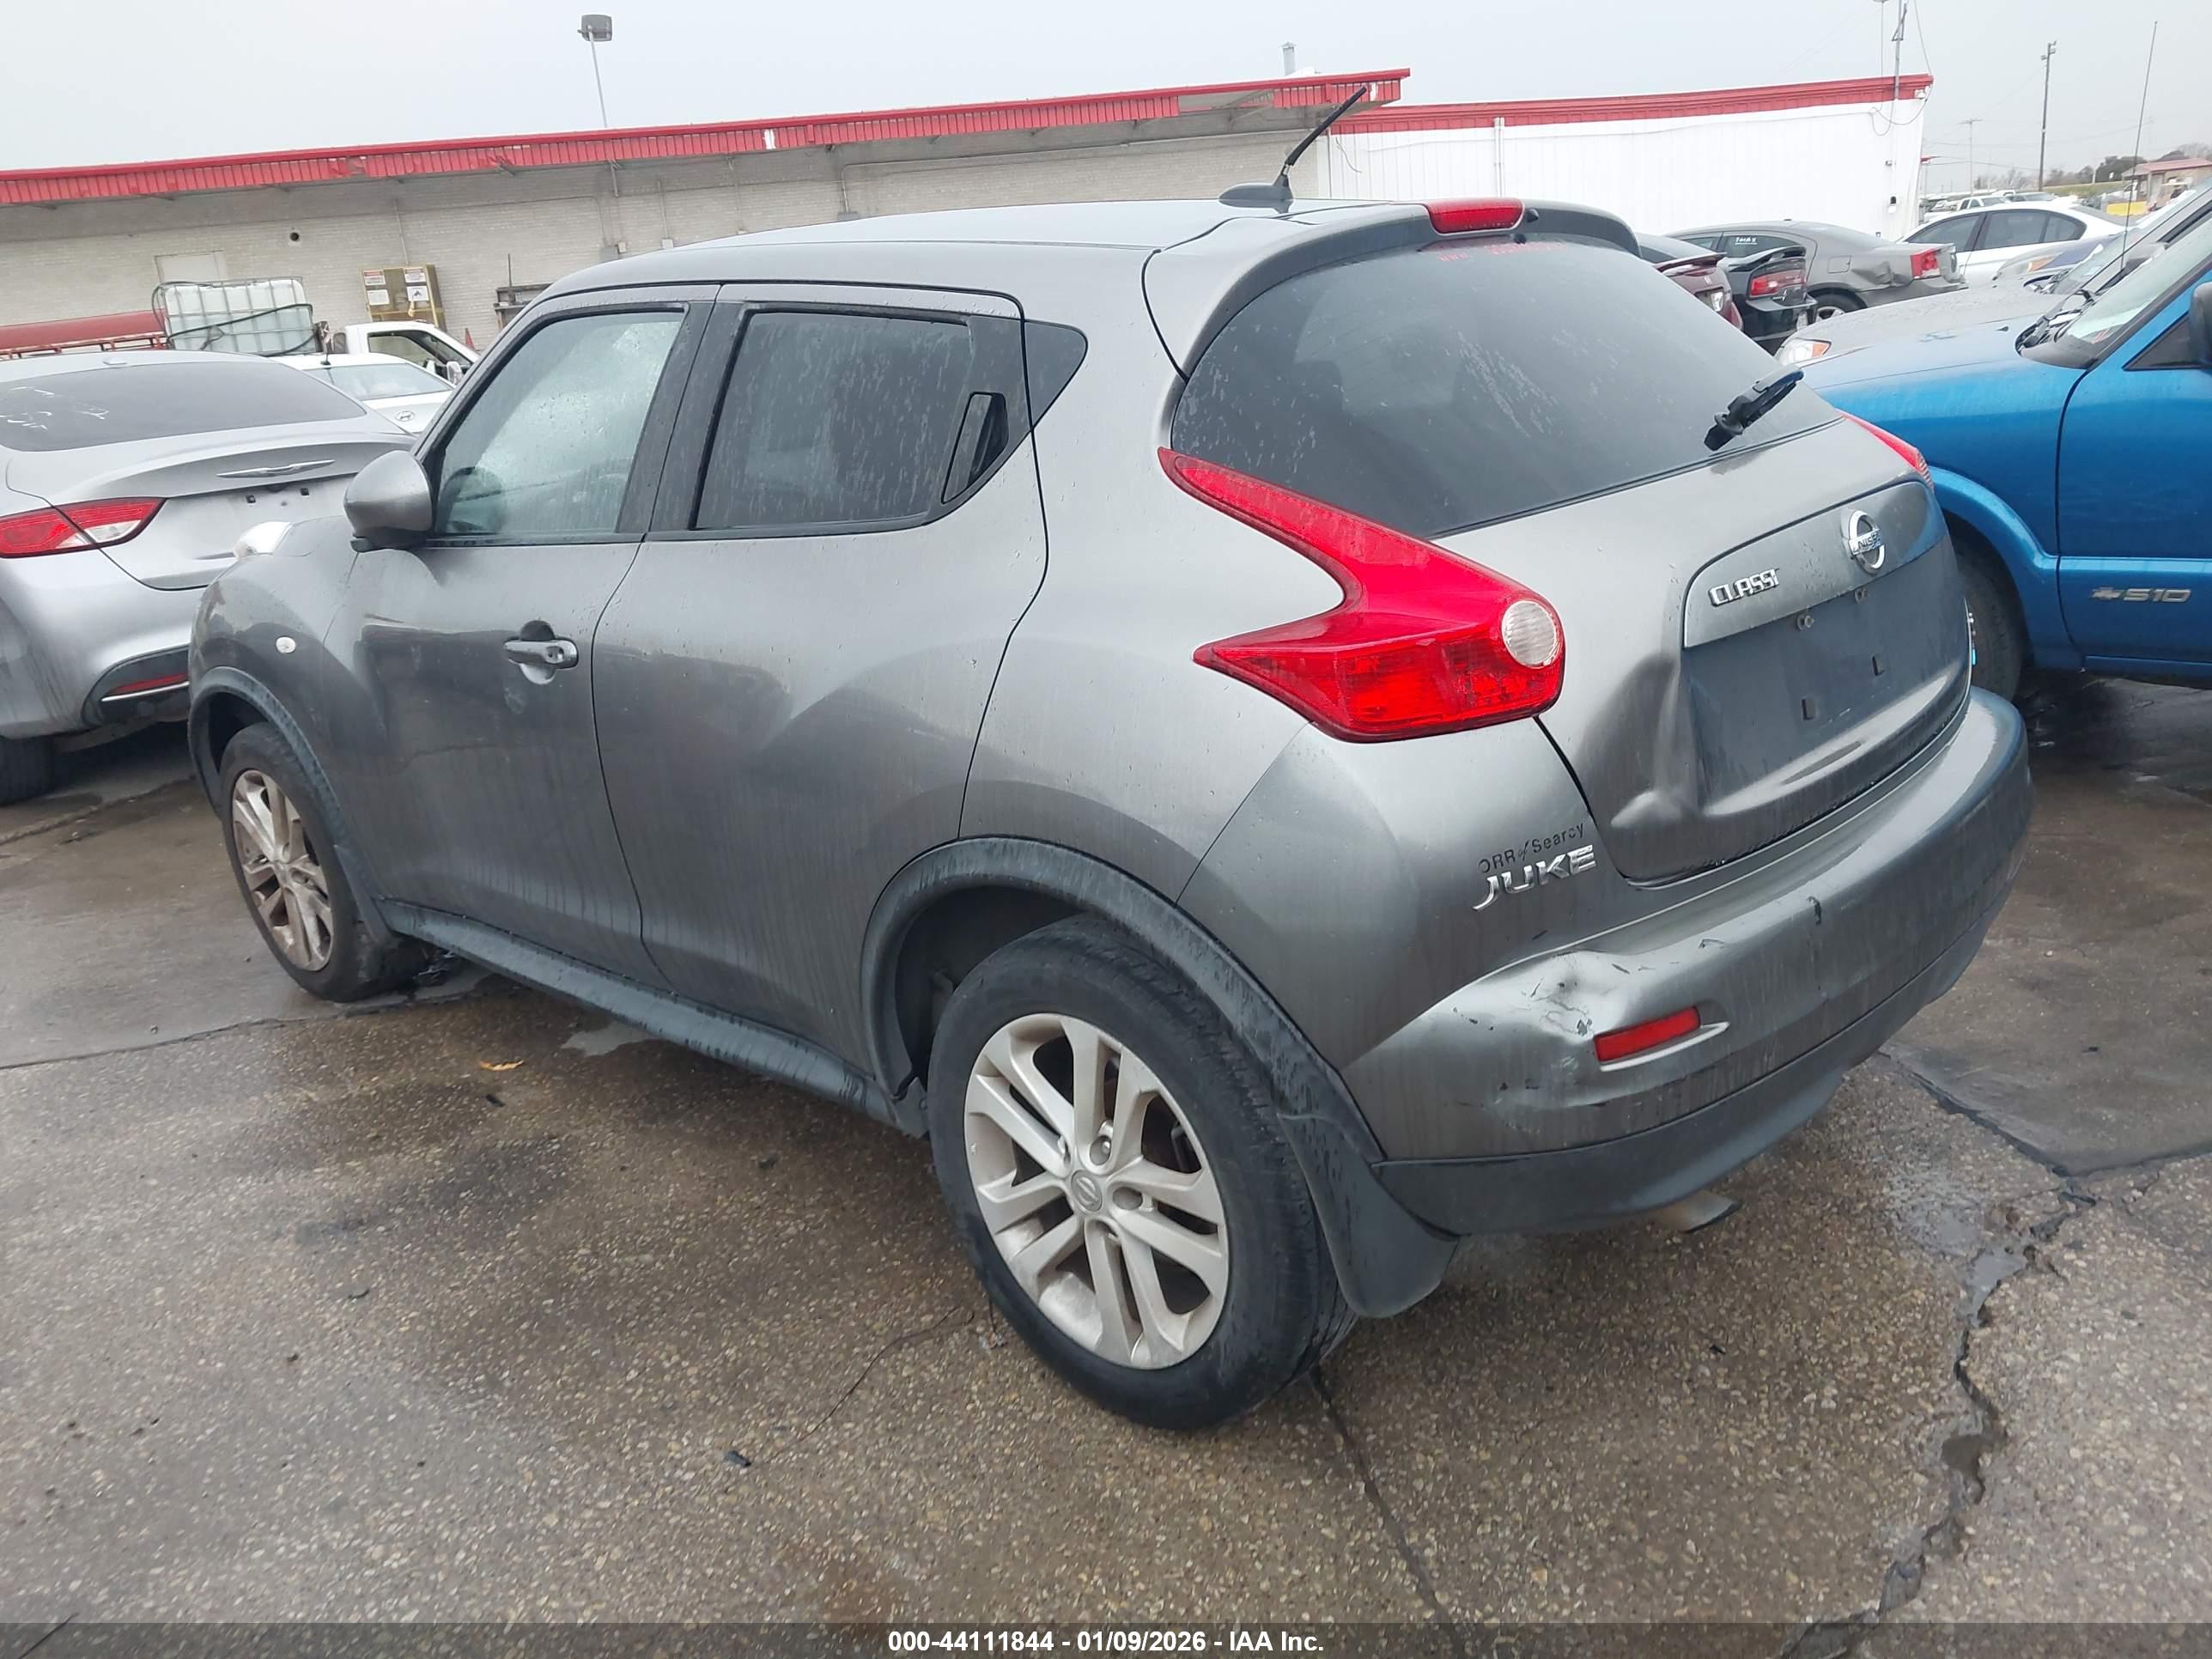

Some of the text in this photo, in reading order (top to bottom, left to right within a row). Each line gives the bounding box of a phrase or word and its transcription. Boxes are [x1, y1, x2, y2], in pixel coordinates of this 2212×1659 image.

[2123, 588, 2191, 603] S10
[1531, 823, 1584, 854] Searcy
[1473, 844, 1597, 911] JUKE
